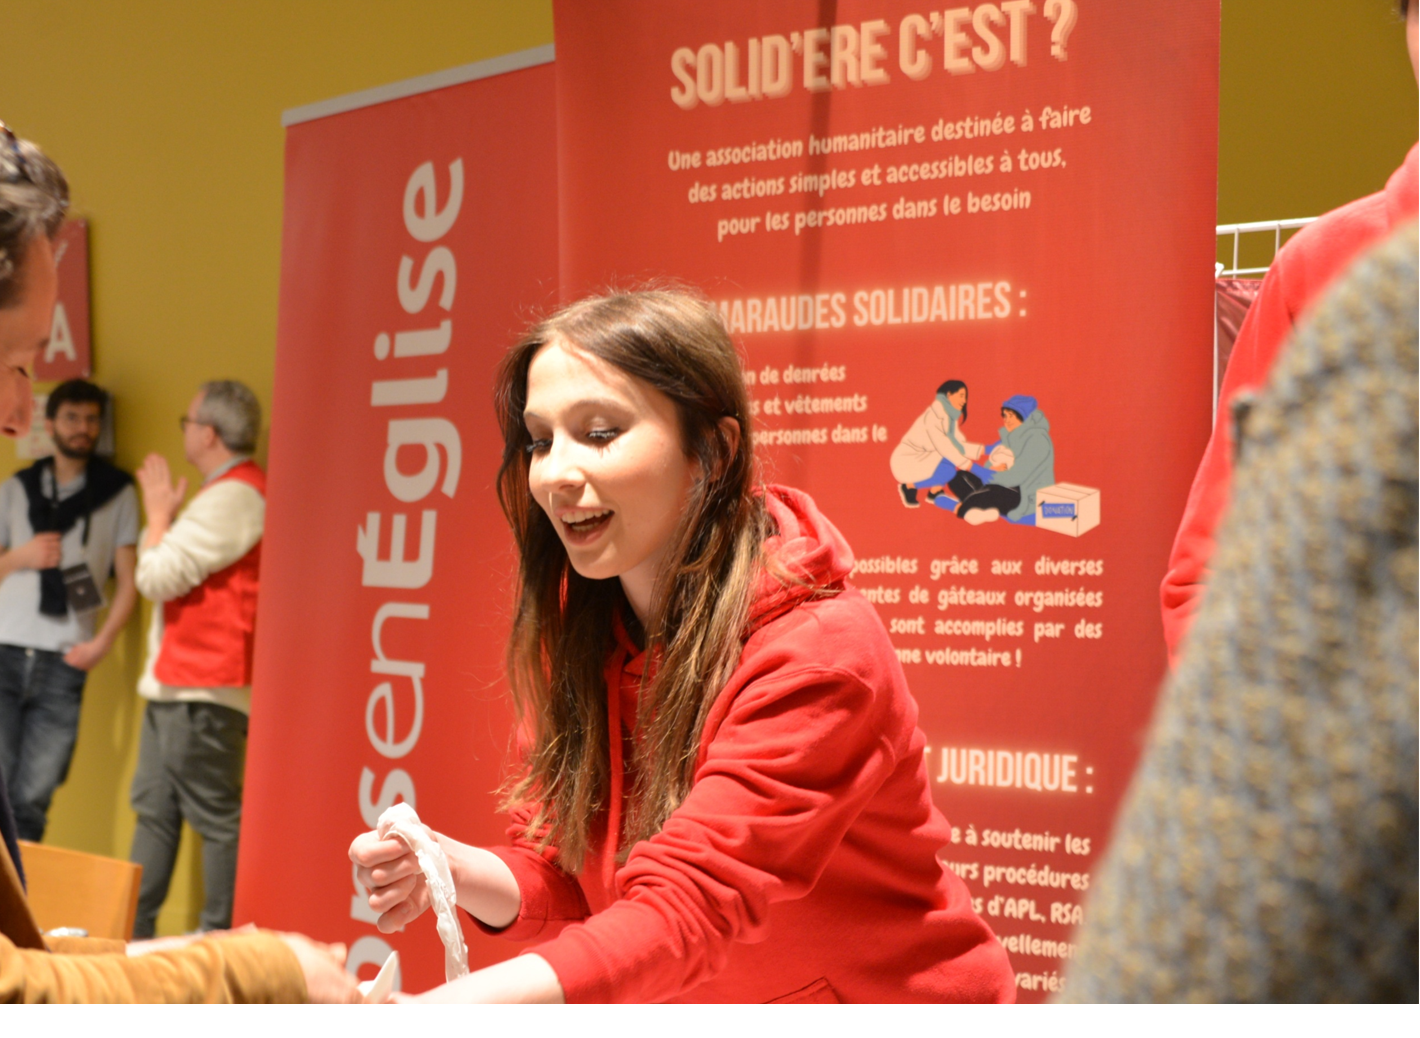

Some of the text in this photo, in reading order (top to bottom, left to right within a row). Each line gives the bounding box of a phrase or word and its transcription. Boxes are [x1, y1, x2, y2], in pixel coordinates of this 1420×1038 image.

[1043, 0, 1078, 62] ?
[667, 105, 1093, 171] Une association humanitaire destinée à faire
[688, 147, 1066, 203] des actions simples et accessibles à tous,
[718, 187, 1032, 243] pour les personnes dans le besoin
[853, 281, 1011, 328] SOLIDAIRES
[44, 303, 77, 363] A
[759, 365, 779, 385] de
[783, 361, 846, 383] denrées
[763, 396, 781, 415] et
[784, 393, 868, 415] vêtements
[751, 423, 887, 446] personnes dans le
[850, 556, 1103, 581] possibles grâce aux diverses
[909, 585, 929, 604] de
[937, 587, 1006, 611] gâteaux
[1014, 587, 1103, 613] organisées
[889, 616, 1102, 643] sont accomplies par des
[925, 647, 1011, 667] volontaire
[1015, 648, 1022, 668] !
[936, 746, 1078, 793] JURIDIQUE
[965, 824, 978, 846] à
[981, 828, 1061, 852] soutenir
[1065, 833, 1091, 855] les
[983, 863, 1090, 890] procédures
